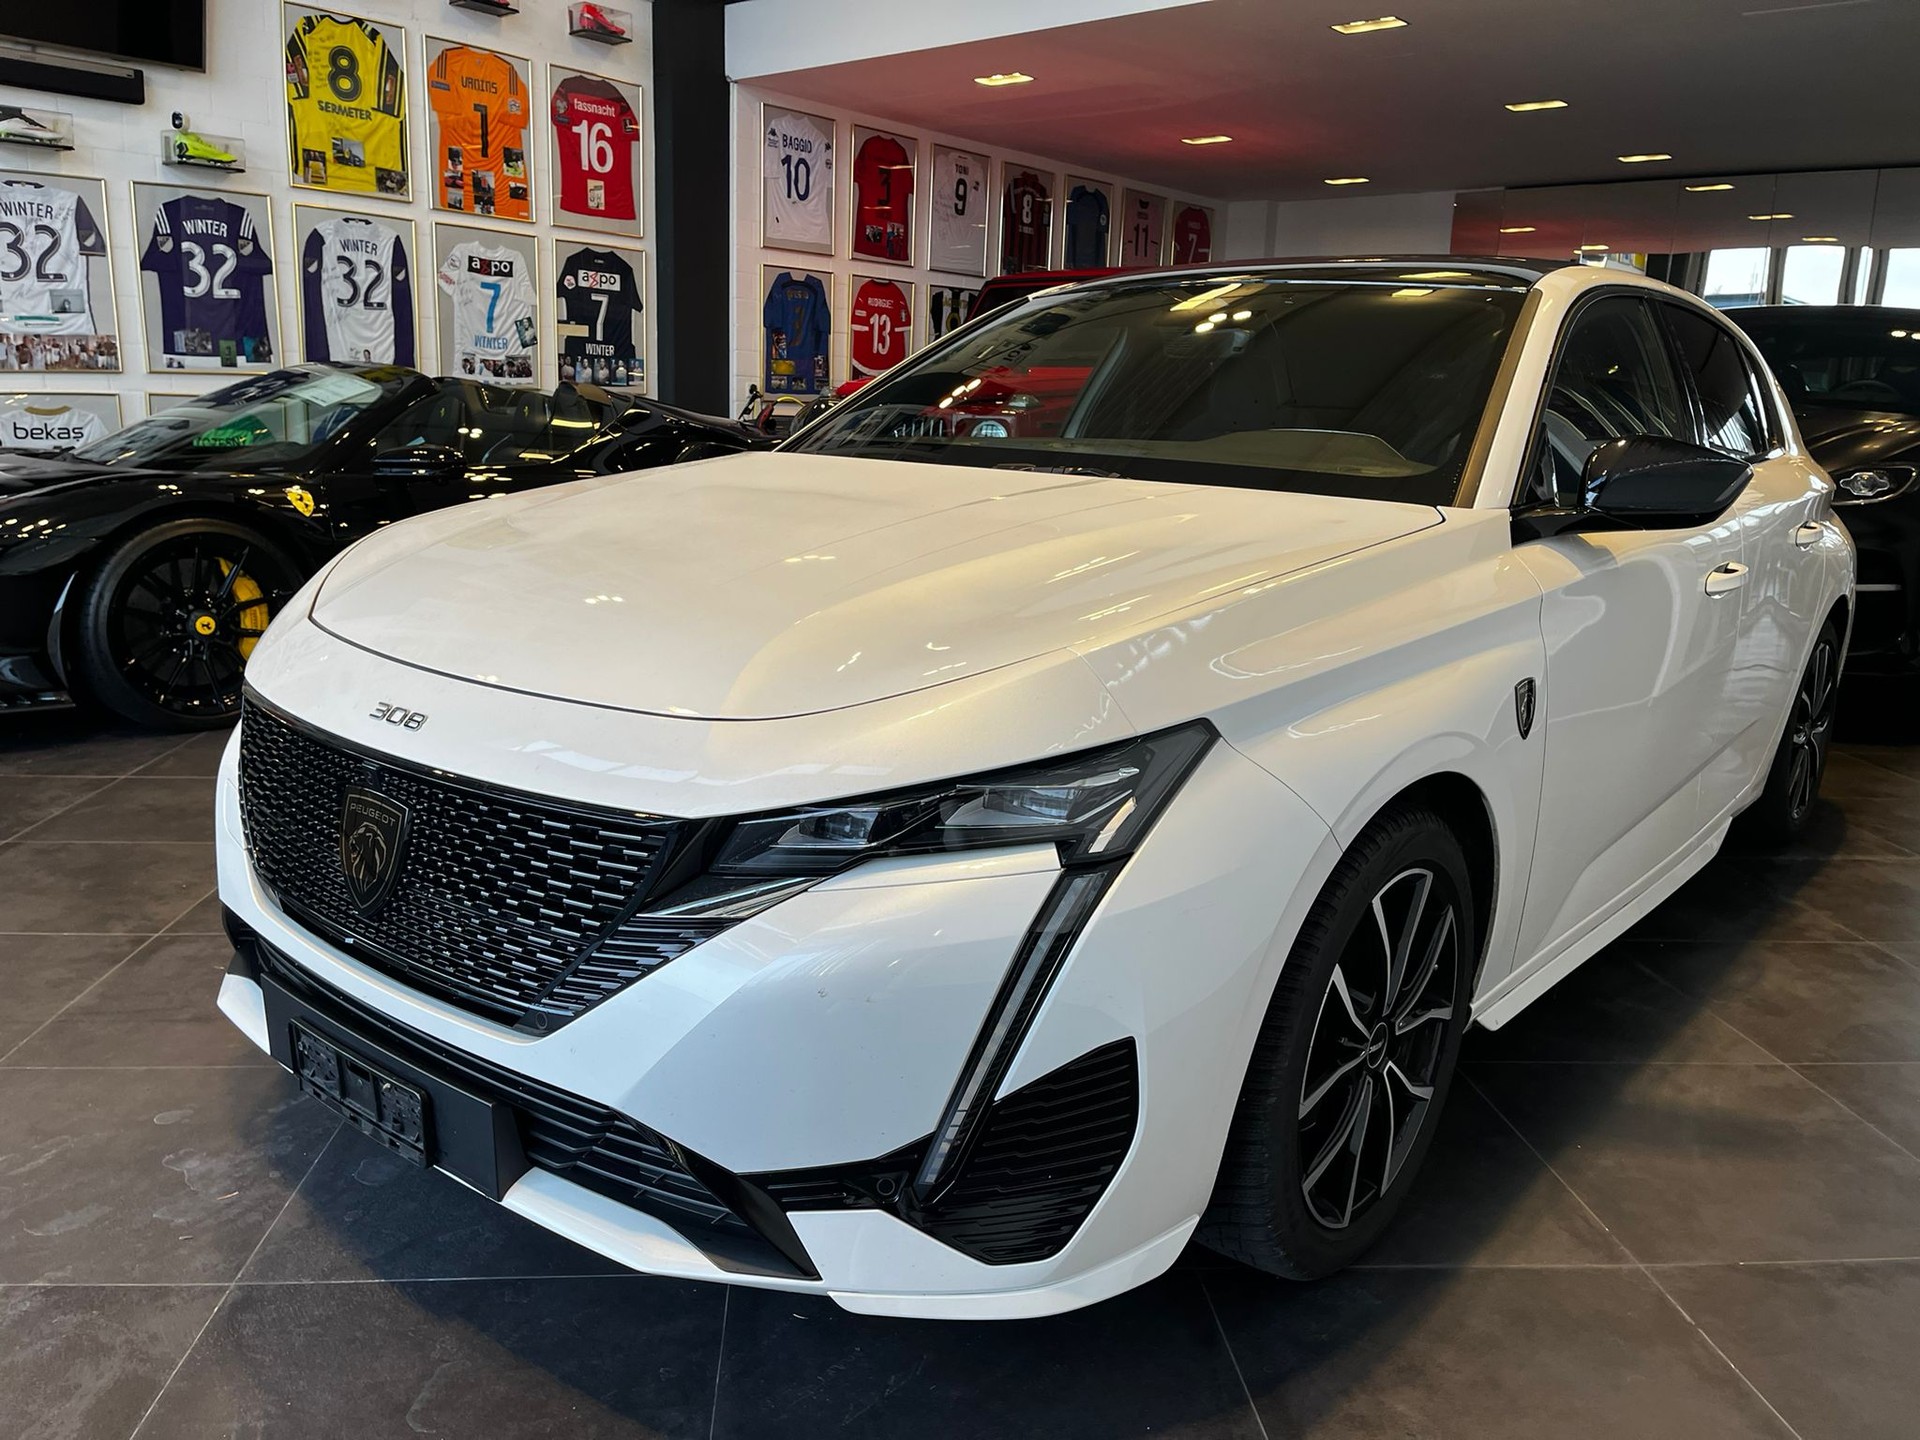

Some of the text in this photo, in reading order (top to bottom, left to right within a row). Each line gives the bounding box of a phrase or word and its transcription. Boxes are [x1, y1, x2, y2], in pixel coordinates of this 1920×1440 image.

[327, 45, 362, 102] 8
[317, 100, 373, 120] SERMETER
[573, 98, 616, 118] fassnacht
[473, 103, 489, 158] 1
[572, 119, 614, 174] 16
[782, 134, 812, 153] BAGGIO
[781, 154, 810, 201] 10
[0, 201, 54, 220] WINTER
[954, 178, 968, 216] 9
[1022, 194, 1032, 224] 8
[182, 219, 228, 238] WINTER
[1133, 223, 1149, 257] 11
[0, 222, 68, 282] 32
[339, 238, 378, 256] WINTER
[1188, 233, 1198, 263] 7
[181, 241, 241, 299] 32
[336, 255, 388, 310] 32
[480, 281, 501, 333] 7
[591, 293, 609, 341] 7
[474, 334, 508, 350] WINTER
[585, 342, 615, 356] WINTER
[869, 313, 891, 355] 13
[369, 701, 429, 731] 308
[349, 802, 396, 827] PEUGEOT
